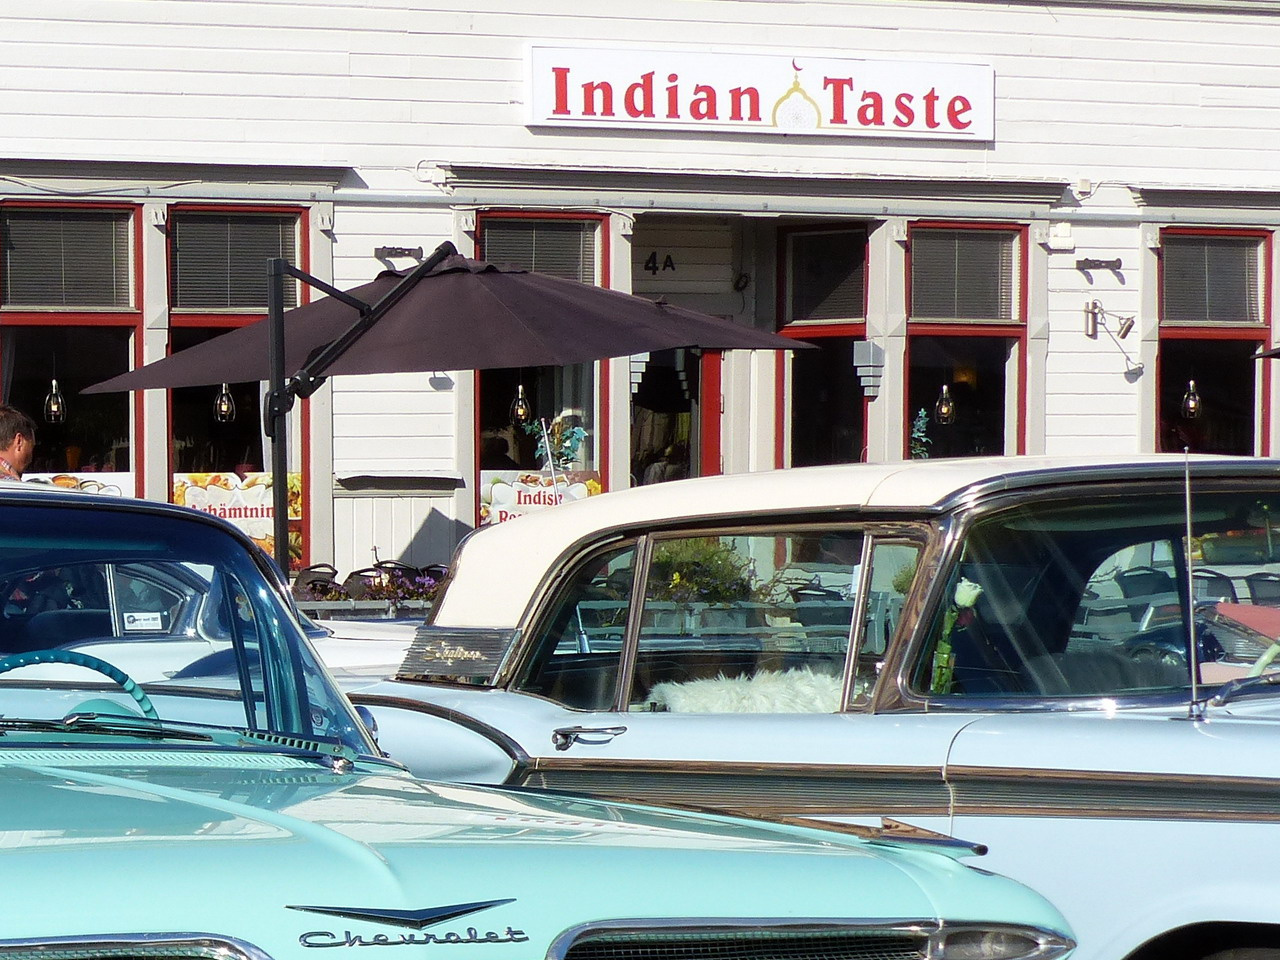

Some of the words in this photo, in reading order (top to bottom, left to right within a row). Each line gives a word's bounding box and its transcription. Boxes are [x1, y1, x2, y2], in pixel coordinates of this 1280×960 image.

[551, 67, 762, 121] Indian
[823, 76, 973, 129] Taste
[298, 926, 530, 948] Chevrolet
